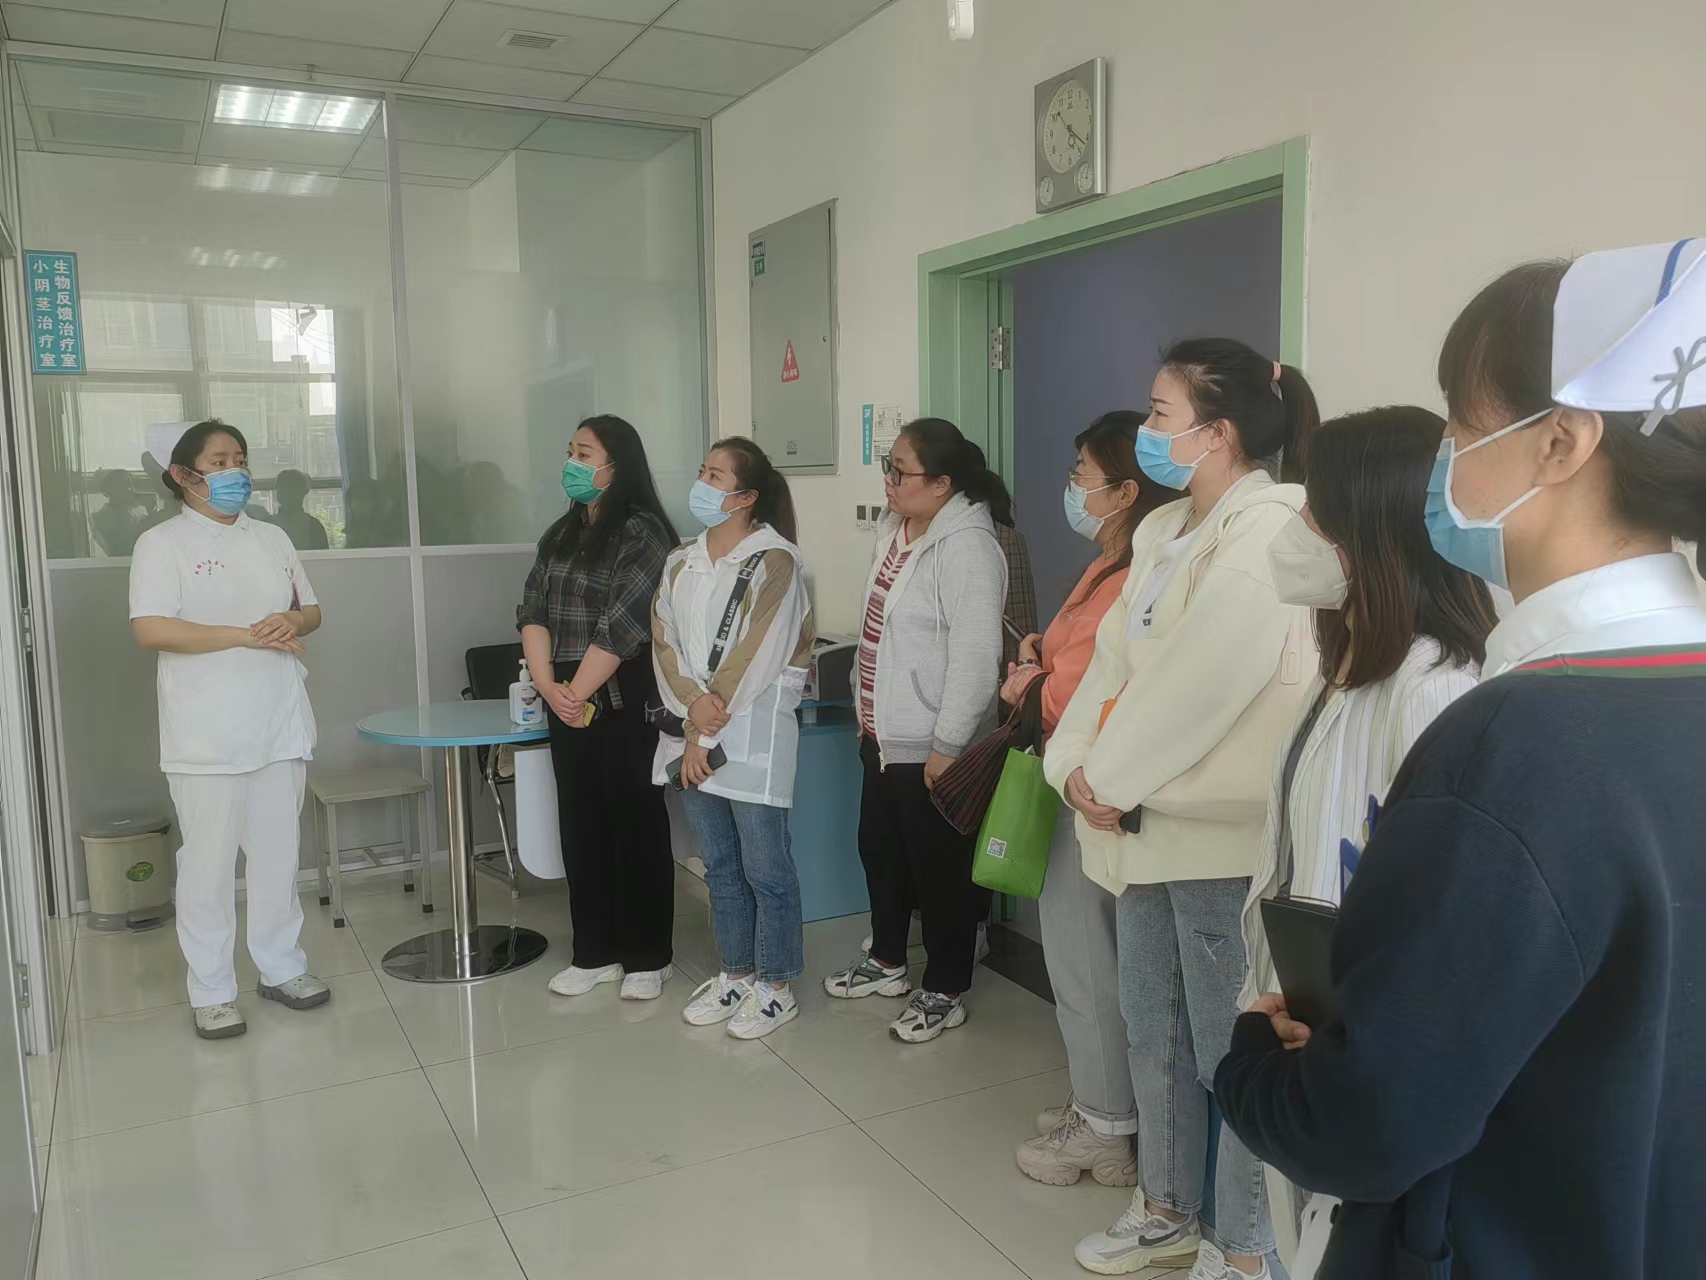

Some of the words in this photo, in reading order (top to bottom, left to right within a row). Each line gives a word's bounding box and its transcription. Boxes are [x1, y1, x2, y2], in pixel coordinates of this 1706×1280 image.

[33, 259, 57, 368] 小阴茎治疗室
[53, 259, 78, 368] 生物反馈治疗室
[725, 599, 738, 624] CLASSIC
